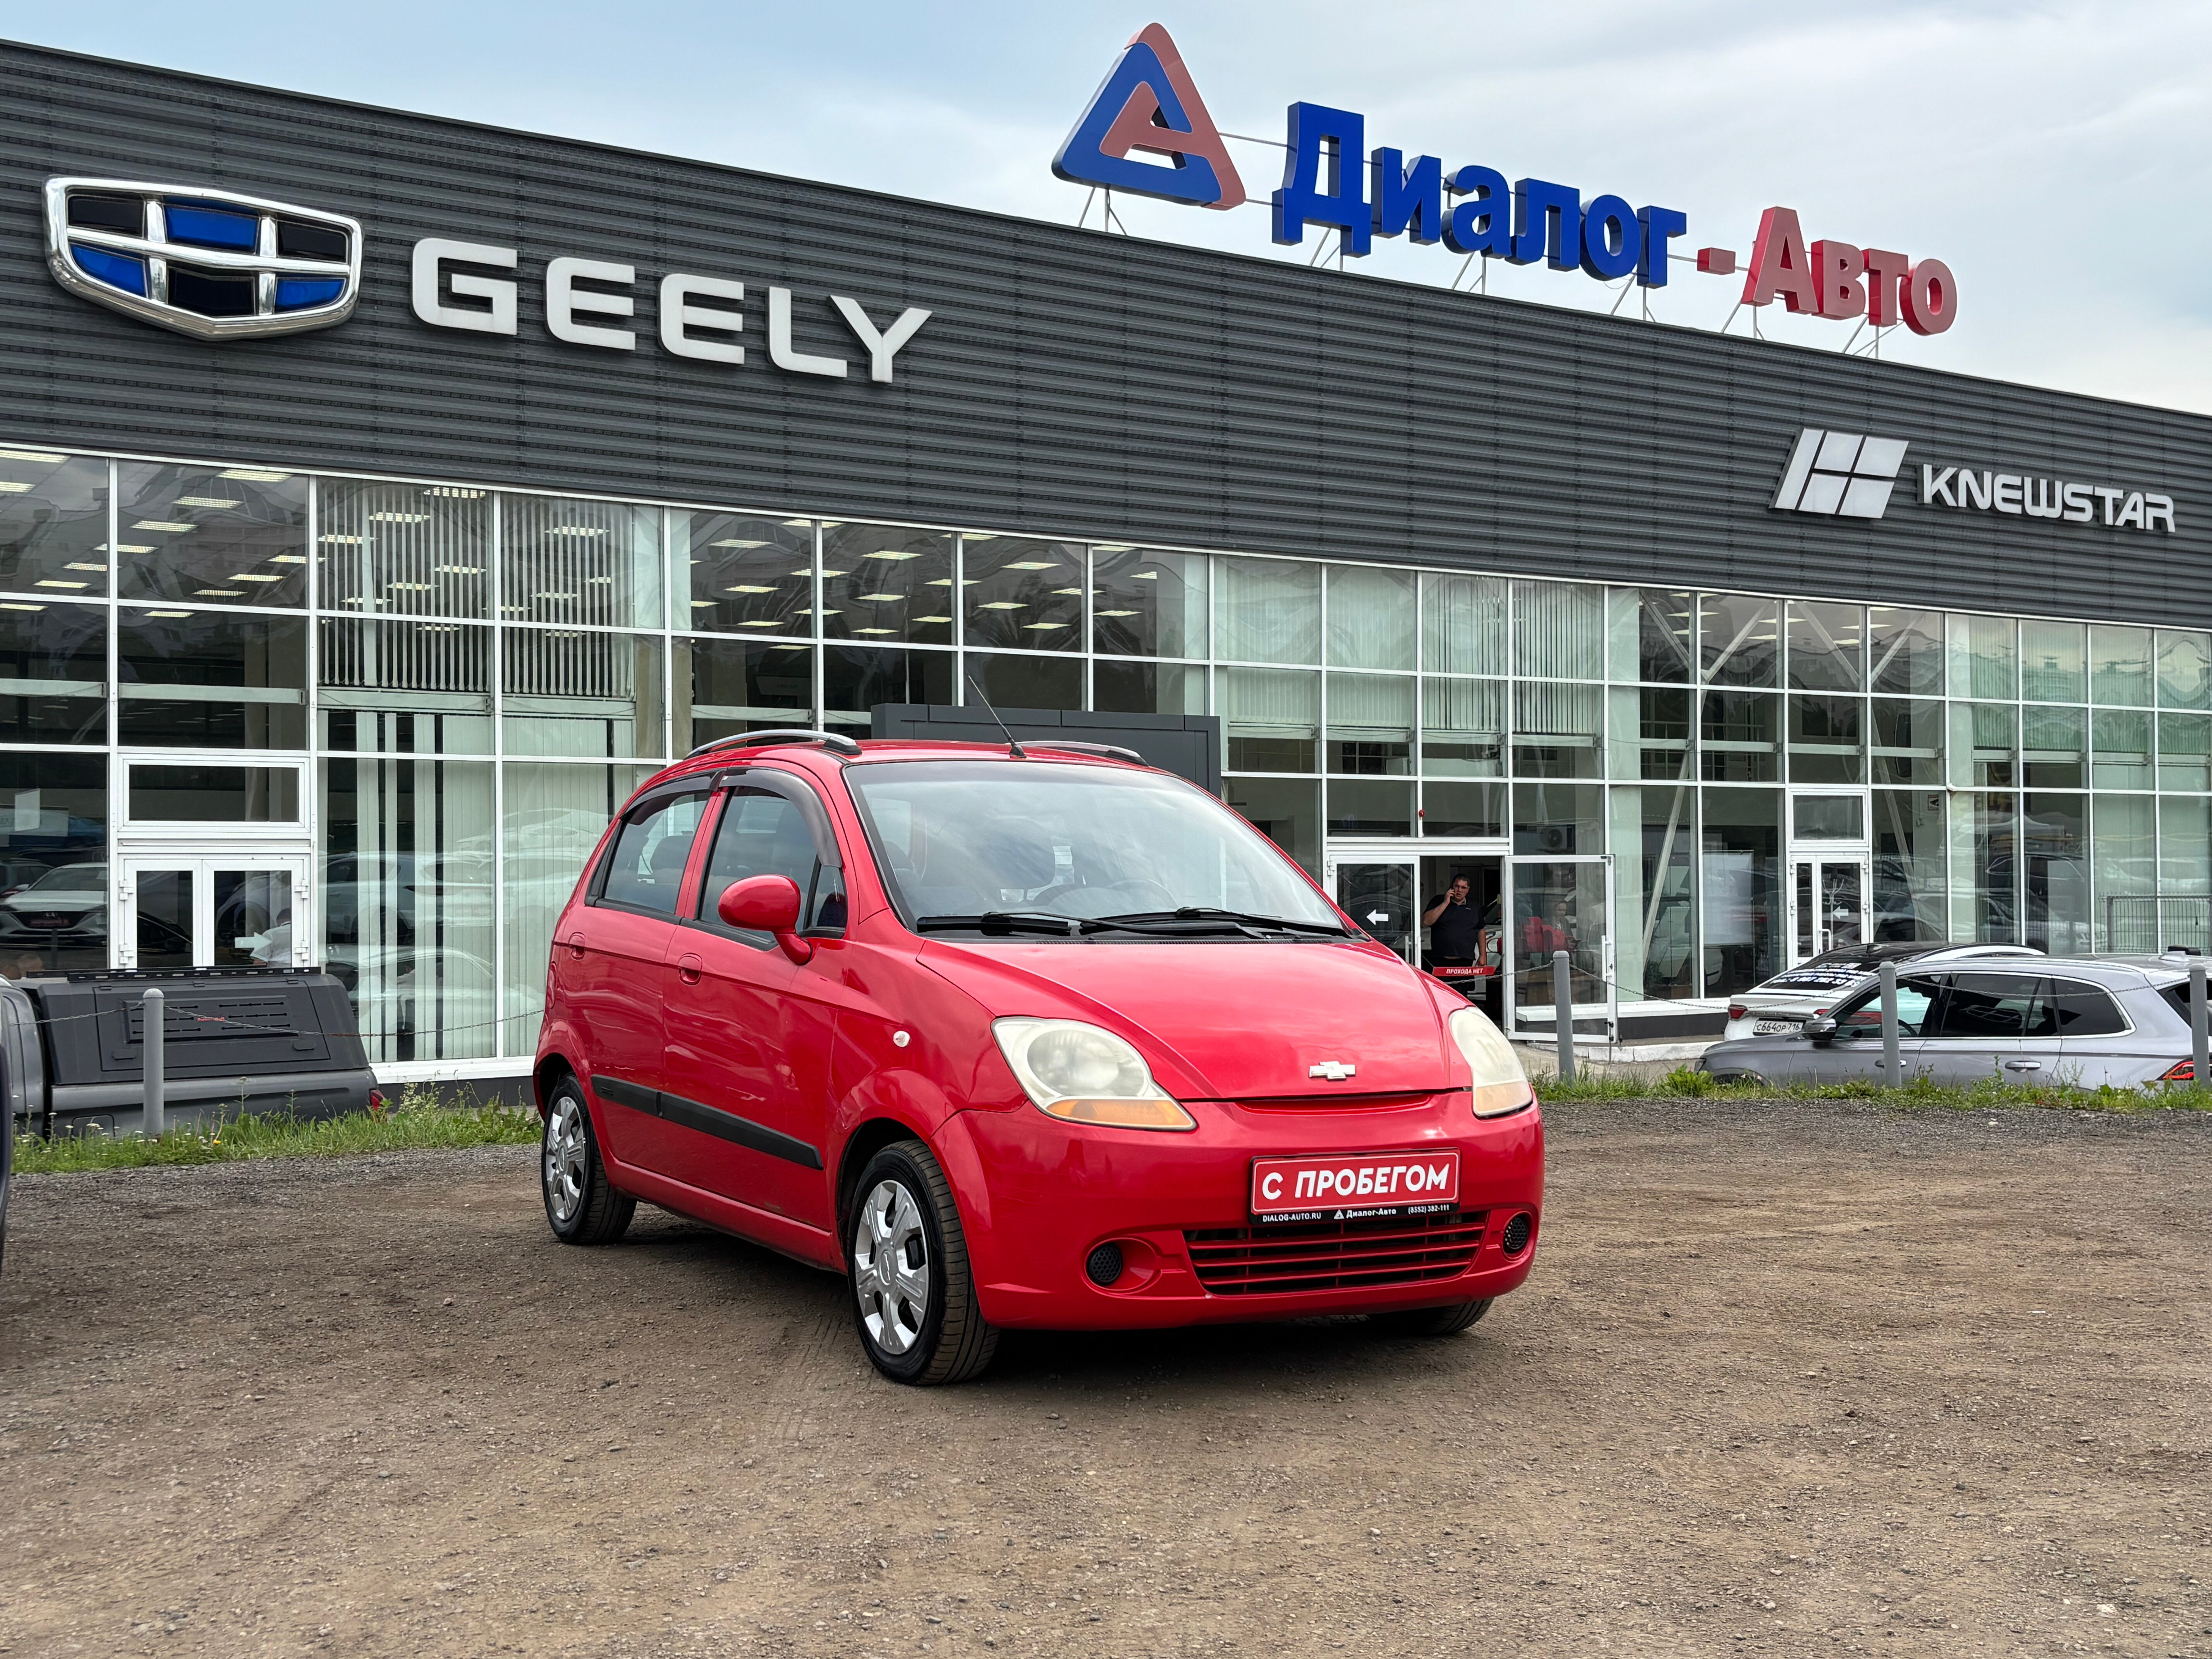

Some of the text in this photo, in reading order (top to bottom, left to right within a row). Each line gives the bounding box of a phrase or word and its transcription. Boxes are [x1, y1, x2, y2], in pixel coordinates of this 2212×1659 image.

[411, 237, 932, 384] GEELY
[1919, 463, 2176, 533] KNEWSTAR
[1262, 1163, 1449, 1200] С ПРОБЕГОМ
[1262, 1212, 1321, 1222] DIALOG-AUTO.RU
[1346, 1208, 1396, 1219] Диалог-Авто
